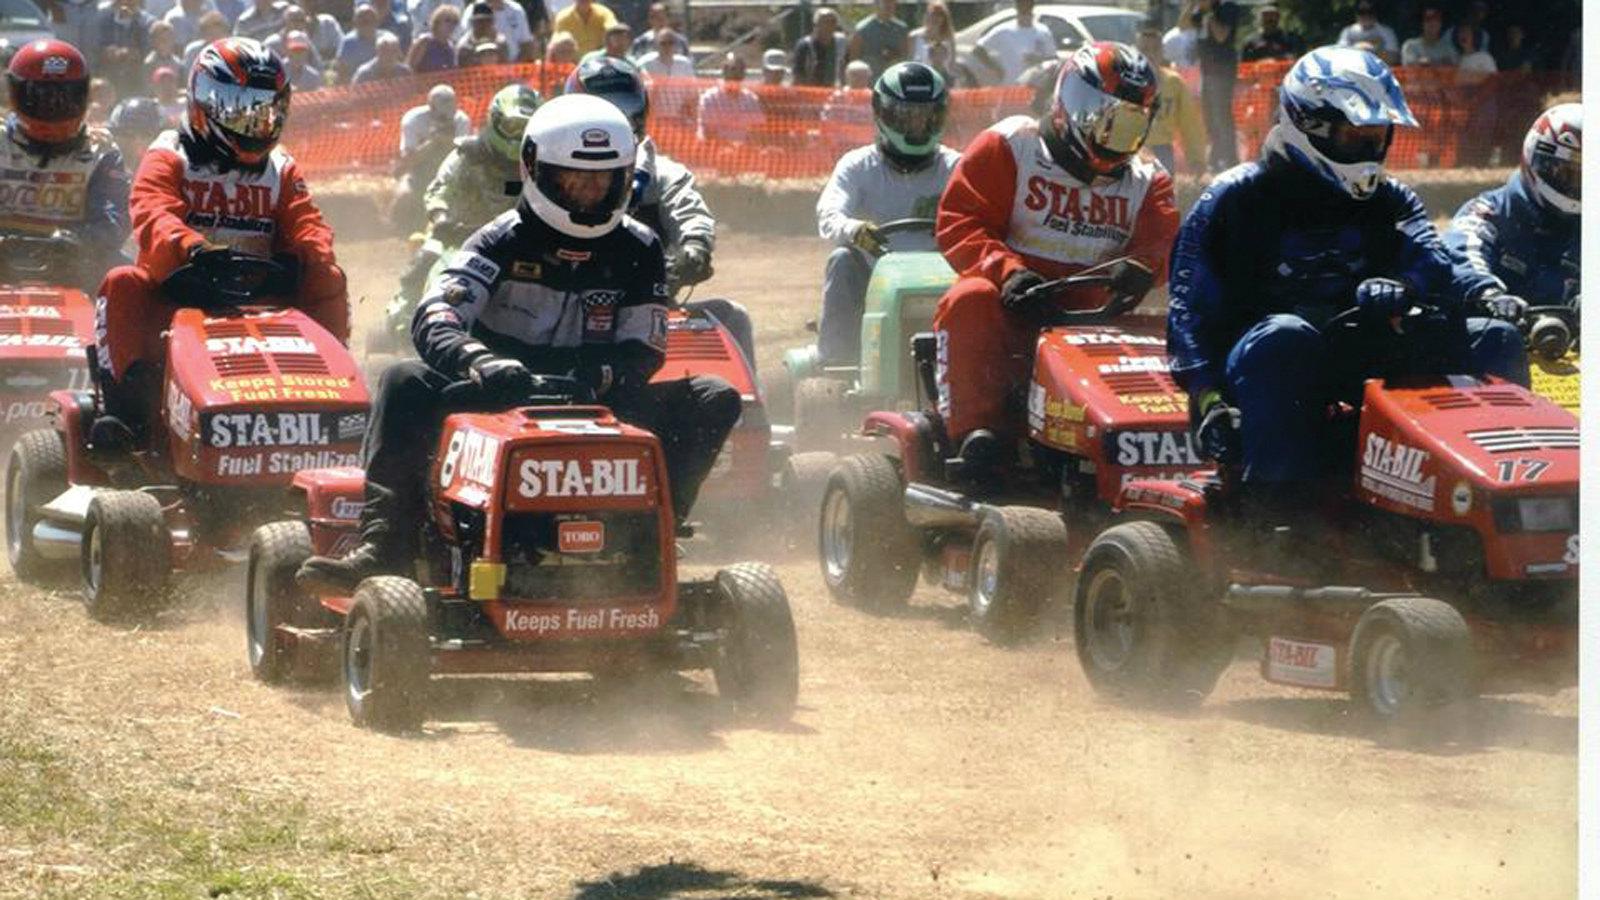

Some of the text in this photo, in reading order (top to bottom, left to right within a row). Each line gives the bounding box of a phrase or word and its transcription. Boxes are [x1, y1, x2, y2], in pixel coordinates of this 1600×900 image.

[1025, 175, 1132, 230] STA-BIL
[1043, 214, 1069, 233] Fuel
[205, 336, 317, 354] STA-BIL
[209, 375, 350, 392] Keeps Stored
[231, 386, 341, 402] Fuel Fresh
[210, 413, 329, 448] STA-BIL
[1117, 431, 1202, 466] STA-
[1363, 431, 1425, 484] STA-BIL
[217, 453, 262, 476] Fuel
[519, 458, 647, 498] STA-BIL
[1495, 457, 1554, 484] 17
[562, 530, 600, 544] TORO
[505, 607, 659, 635] Keeps Fuel Fresh
